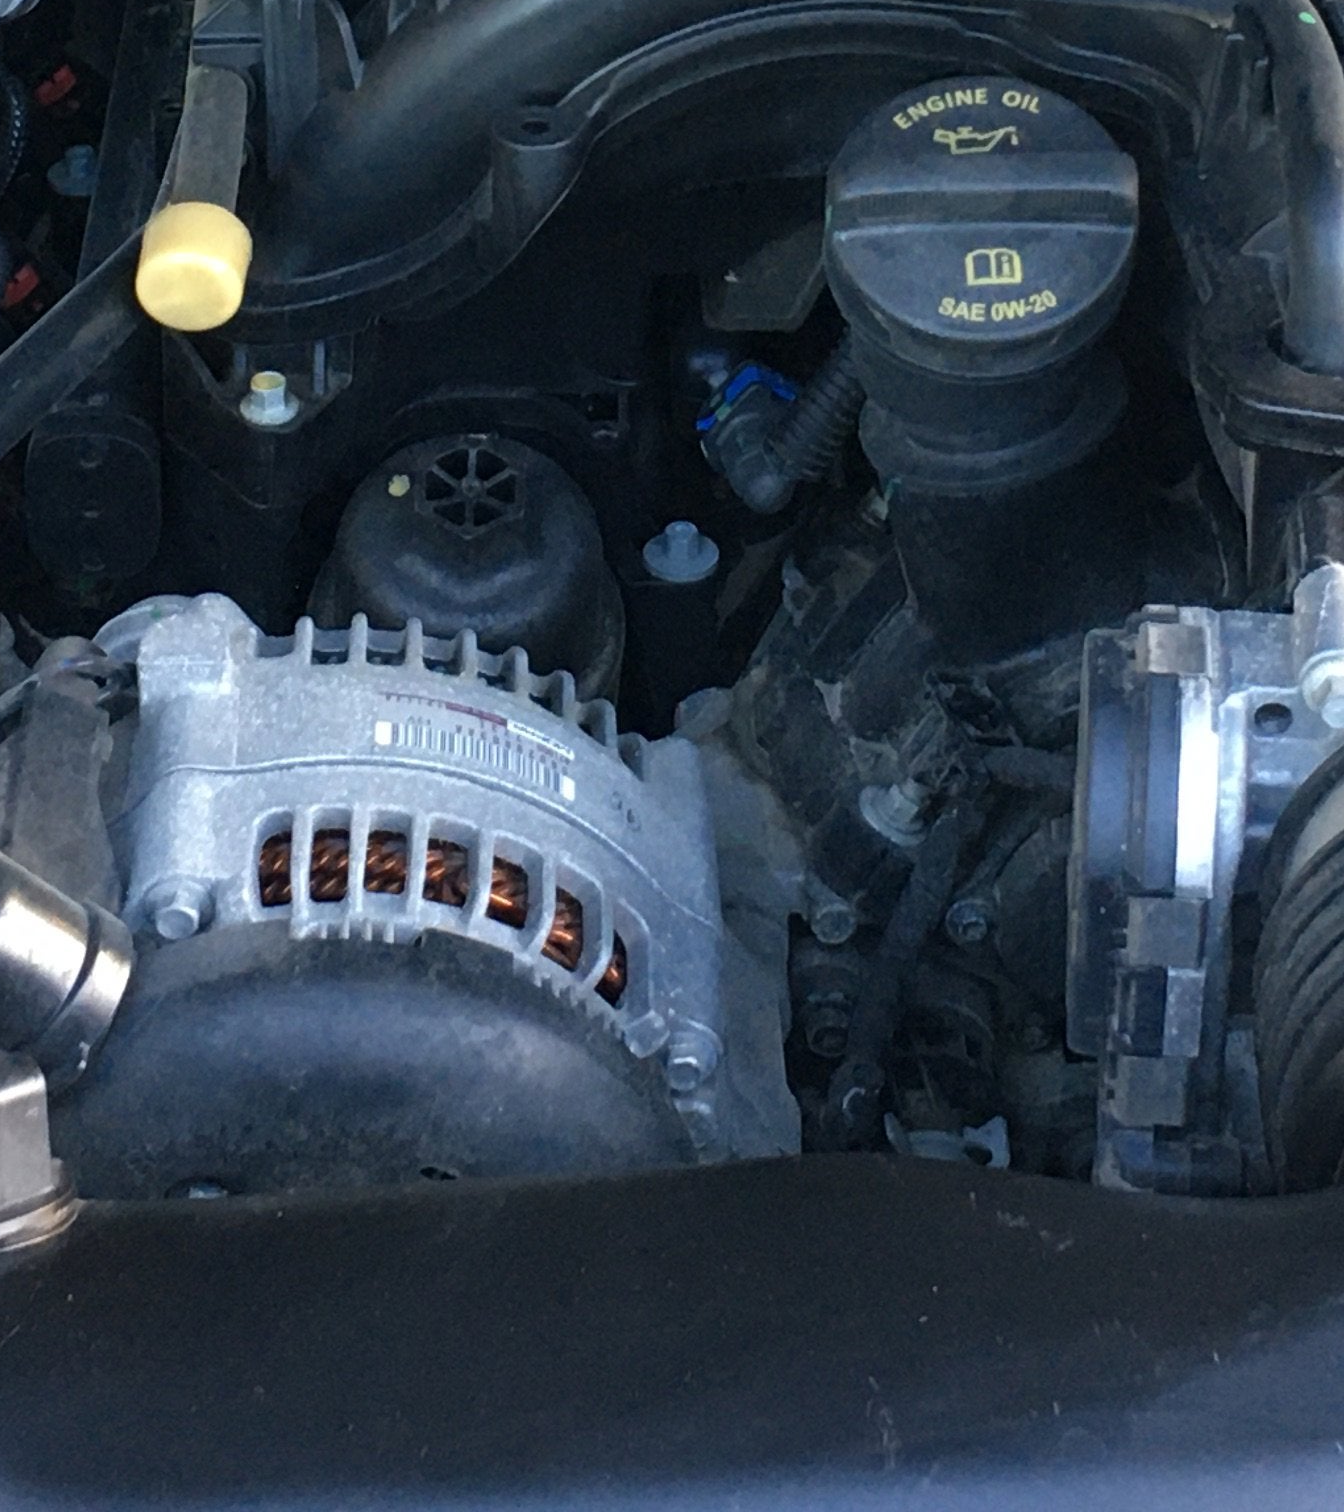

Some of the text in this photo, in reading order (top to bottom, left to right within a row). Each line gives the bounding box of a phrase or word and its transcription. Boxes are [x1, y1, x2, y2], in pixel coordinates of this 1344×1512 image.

[892, 87, 1043, 131] ENGINE OIL
[938, 290, 1058, 323] SAE 0W-20
